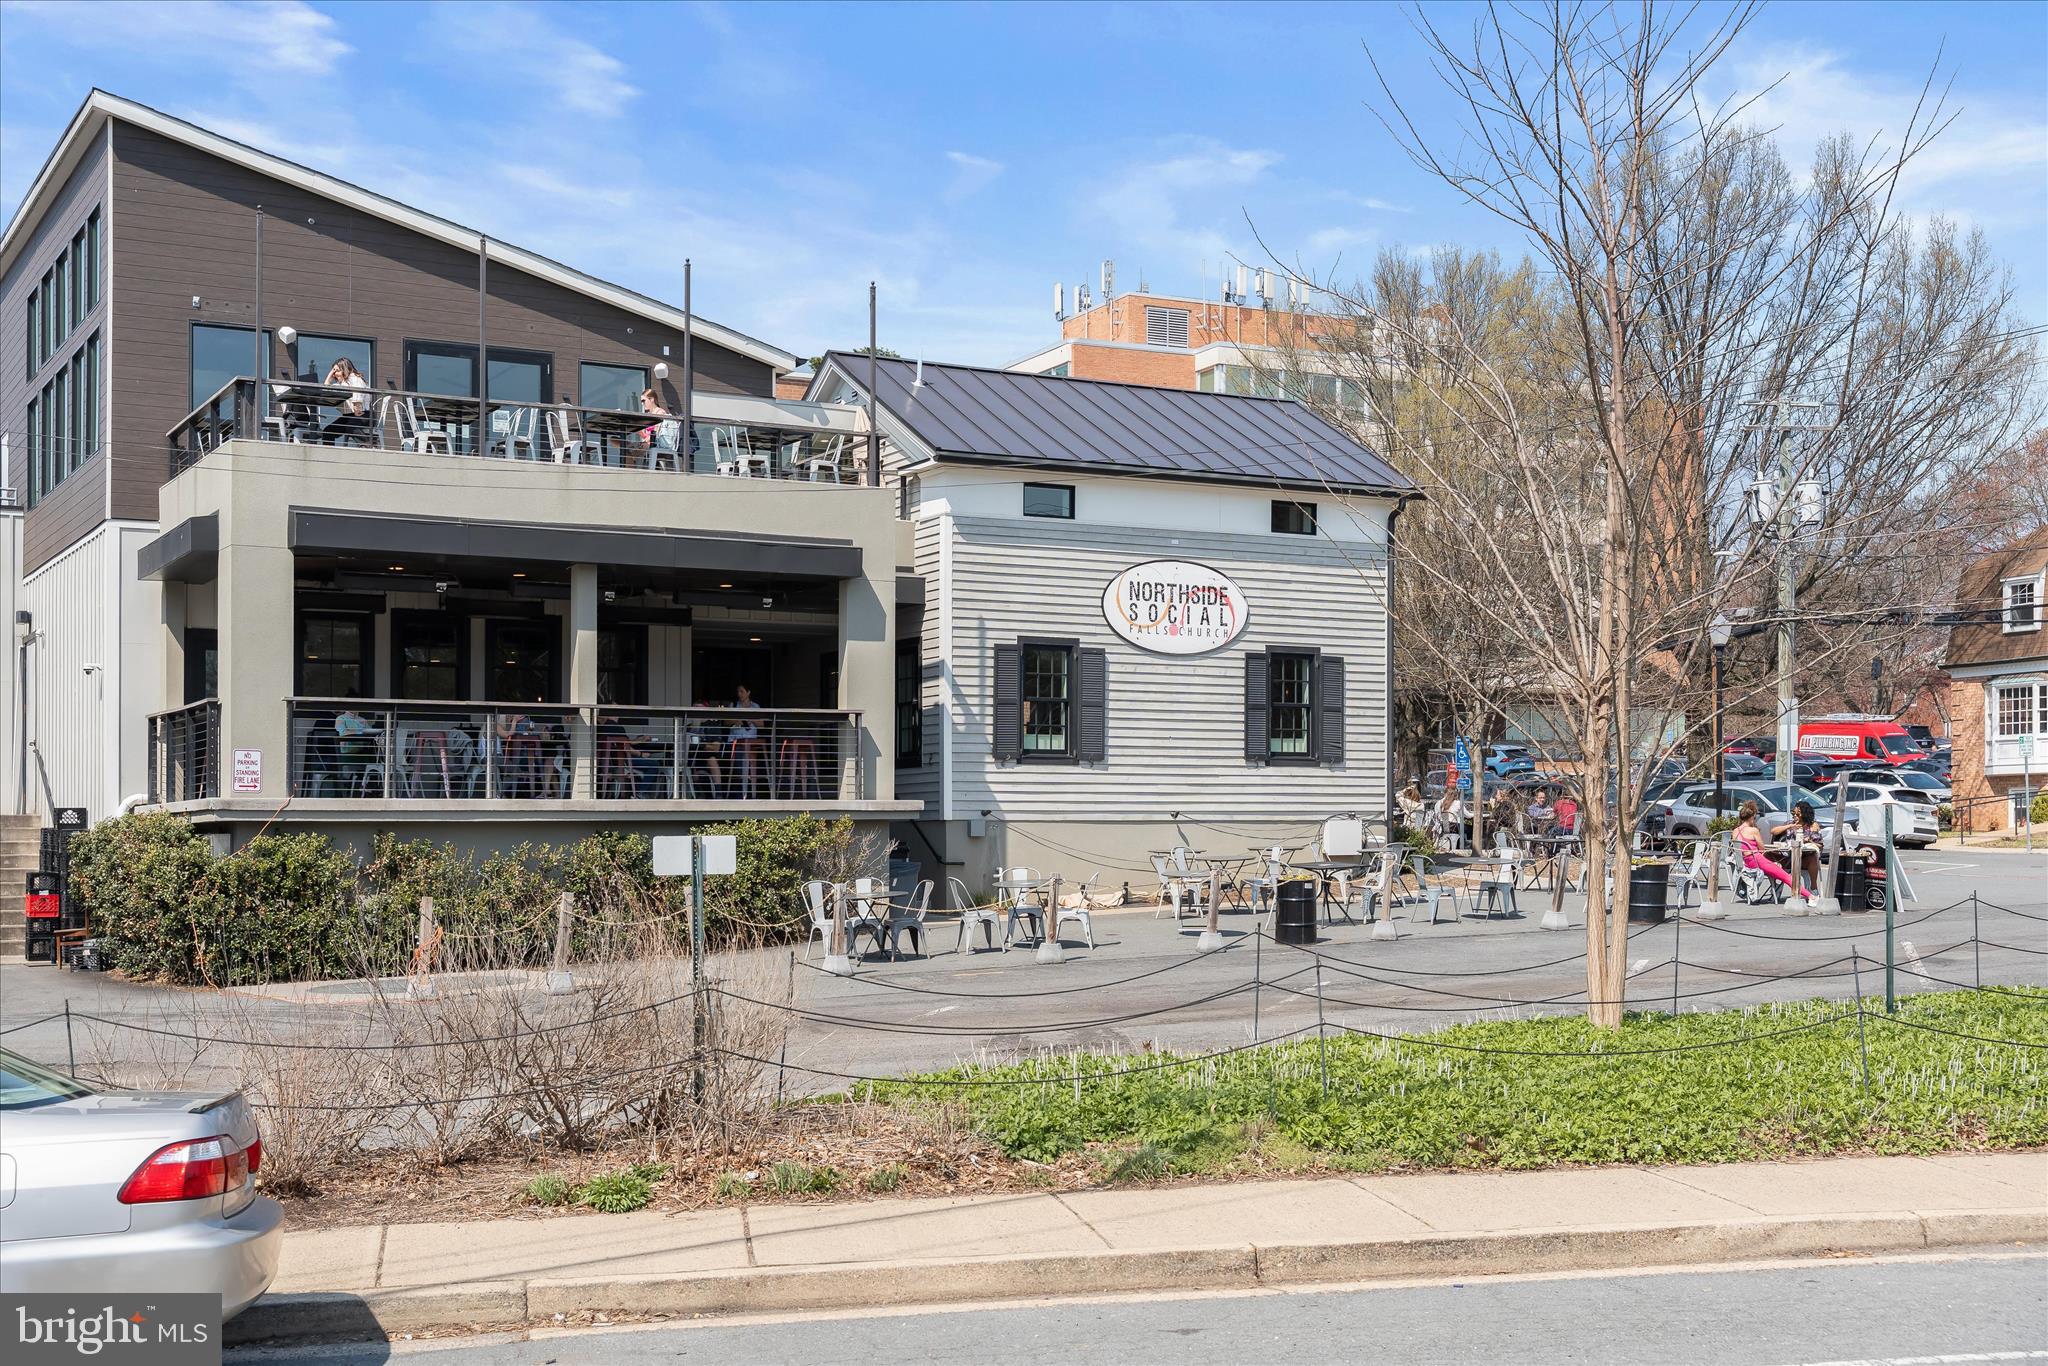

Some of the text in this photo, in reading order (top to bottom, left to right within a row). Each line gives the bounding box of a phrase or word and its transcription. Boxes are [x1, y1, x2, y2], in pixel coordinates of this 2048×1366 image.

[1129, 580, 1229, 607] NORTHSIDE
[1129, 602, 1228, 628] SOCIAL
[1129, 623, 1229, 639] FALLS CHURCH
[1800, 737, 1811, 748] ALL
[234, 776, 260, 784] FIRE LANE
